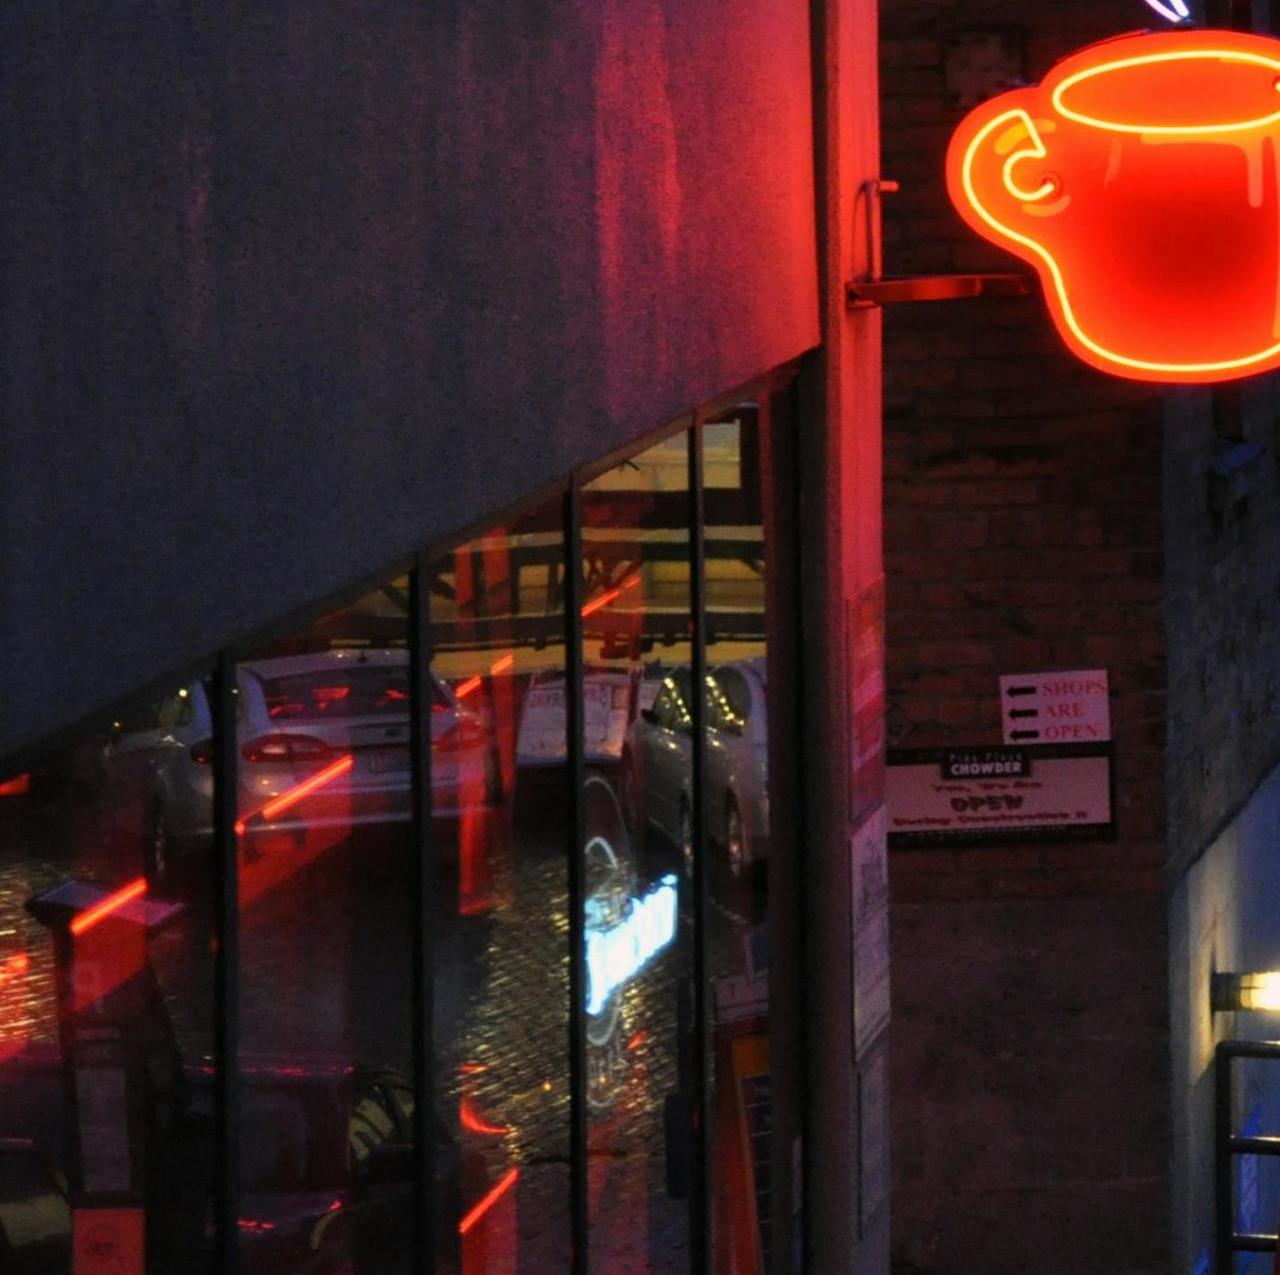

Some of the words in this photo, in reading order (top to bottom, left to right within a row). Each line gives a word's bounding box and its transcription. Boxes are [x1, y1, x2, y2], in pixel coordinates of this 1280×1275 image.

[1042, 679, 1106, 697] SHOPS
[1046, 703, 1084, 718] ARE
[1045, 724, 1099, 739] OPEN
[950, 761, 1023, 776] CHOWDER
[950, 795, 1024, 813] OPEN
